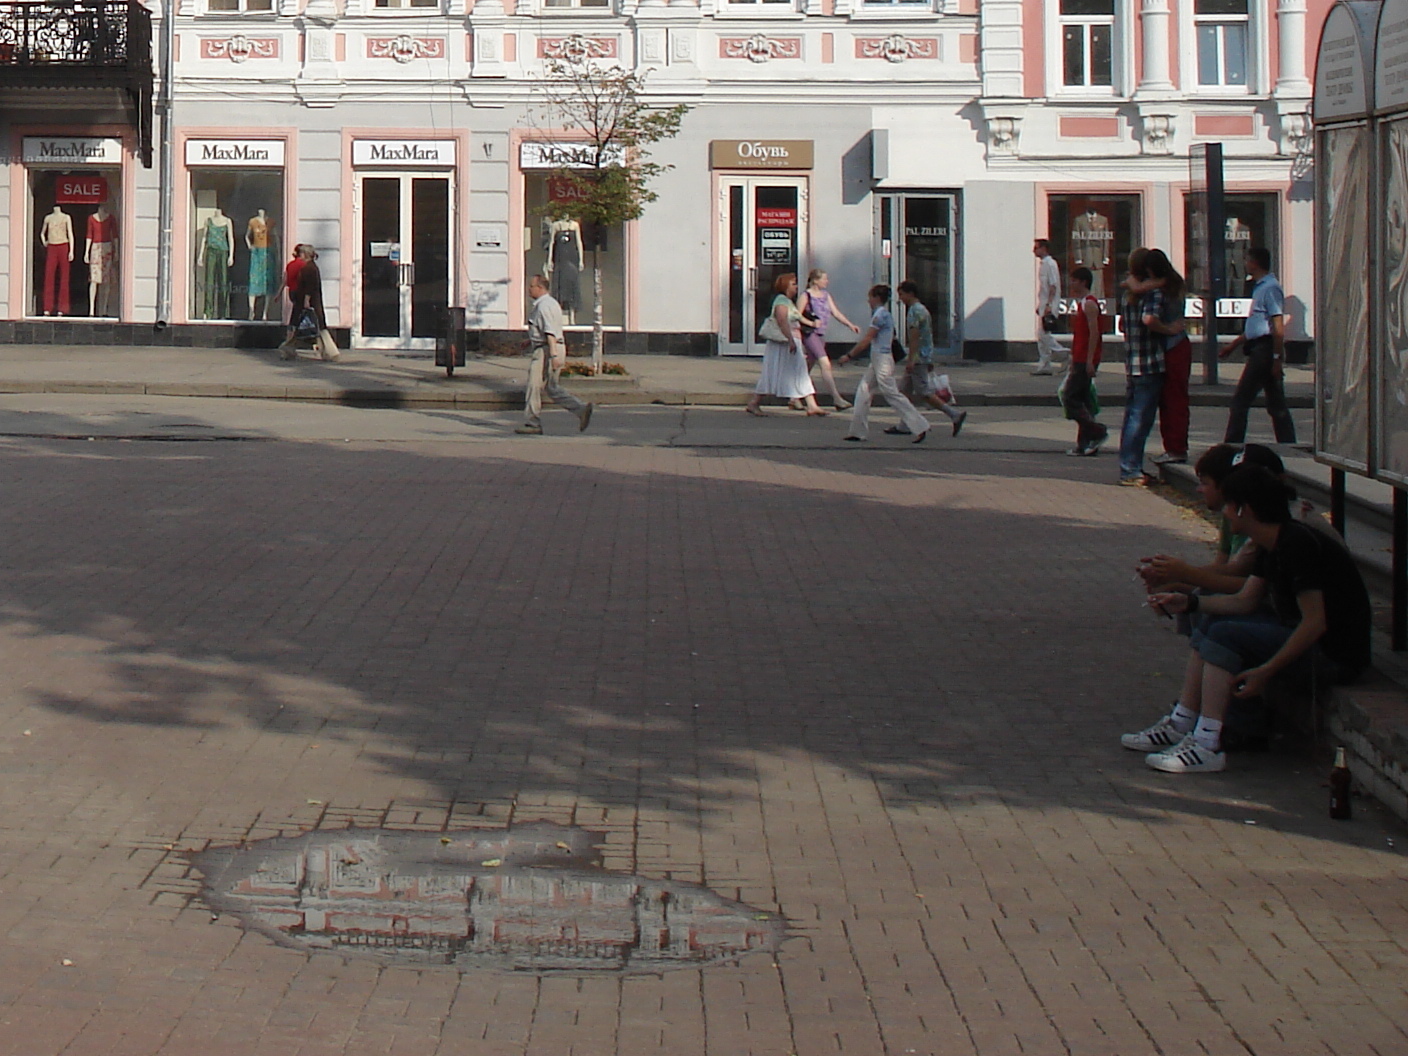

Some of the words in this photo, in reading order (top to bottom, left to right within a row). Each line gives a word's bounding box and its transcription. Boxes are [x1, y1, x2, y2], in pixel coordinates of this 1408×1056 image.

[40, 142, 105, 158] MaxMara
[202, 144, 269, 160] MaxMara
[370, 144, 439, 160] MaxMara
[738, 141, 789, 161] Обувь
[63, 183, 101, 196] SALE
[555, 186, 591, 198] SAL
[905, 227, 920, 236] PAL
[921, 227, 947, 236] ZILERI
[1072, 230, 1087, 239] PAL
[1058, 298, 1107, 314] SAE
[1192, 300, 1242, 315] SLE
